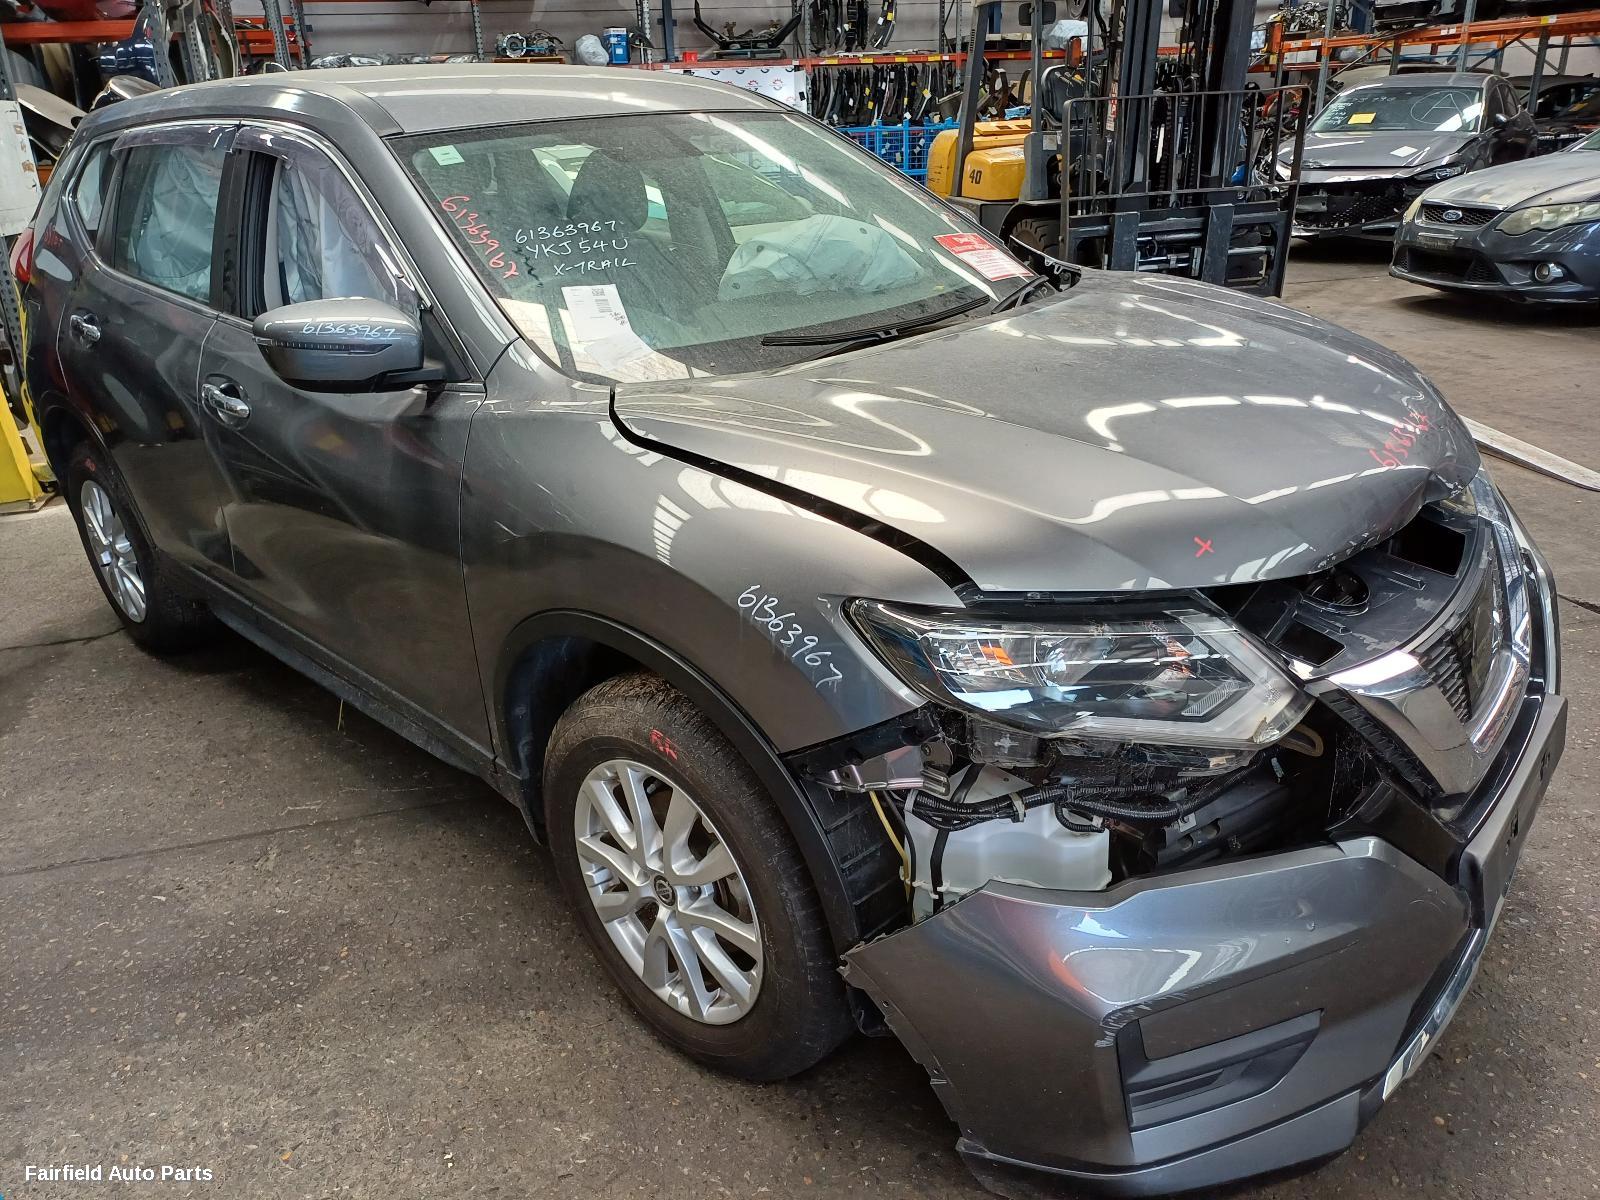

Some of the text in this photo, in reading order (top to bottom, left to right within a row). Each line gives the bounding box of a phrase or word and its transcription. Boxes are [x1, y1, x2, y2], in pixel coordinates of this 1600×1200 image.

[968, 168, 983, 185] 40
[515, 220, 616, 244] 61363967
[525, 240, 573, 259] YKJ
[553, 257, 637, 276] X-TRAIL
[302, 321, 395, 338] 61363967
[737, 584, 843, 689] 61363967
